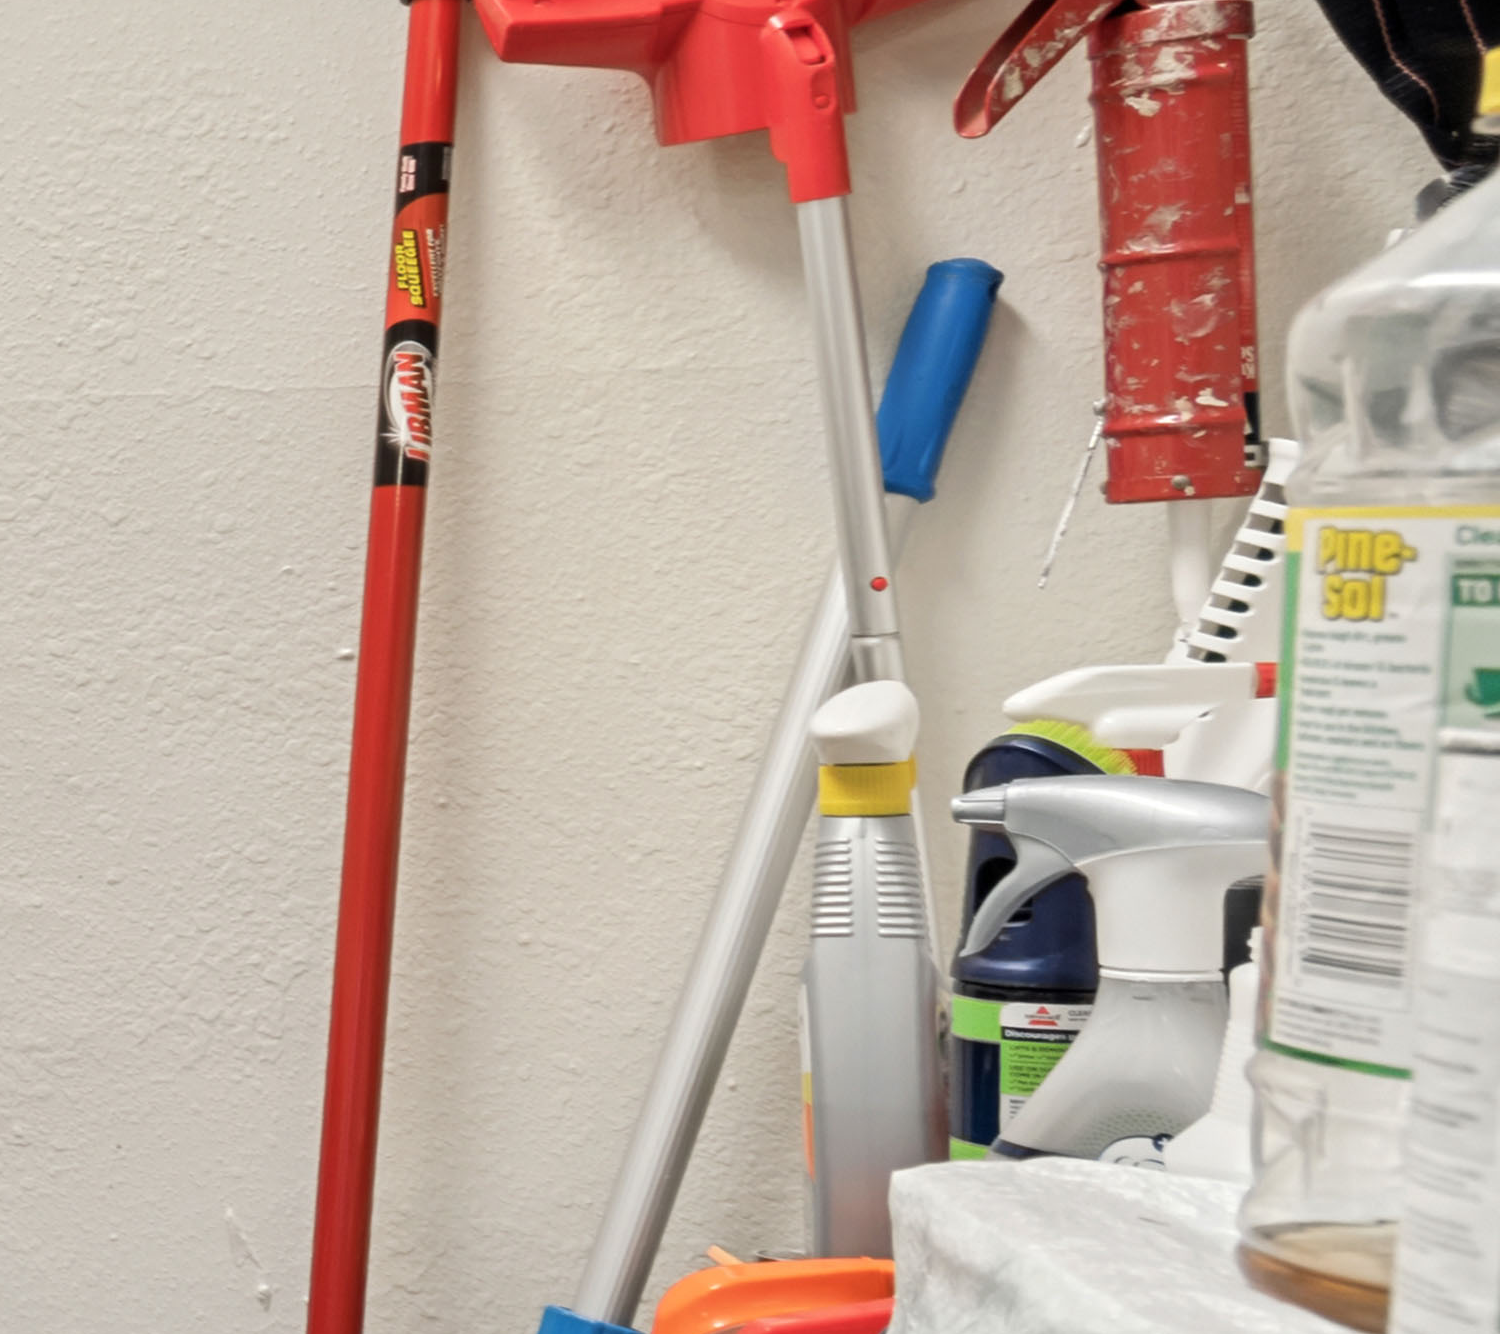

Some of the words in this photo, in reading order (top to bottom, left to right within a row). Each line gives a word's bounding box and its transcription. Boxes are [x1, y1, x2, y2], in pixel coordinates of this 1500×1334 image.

[395, 244, 409, 291] FLOOR
[402, 229, 425, 307] SQUEEGEE
[394, 351, 432, 463] LIBMAN
